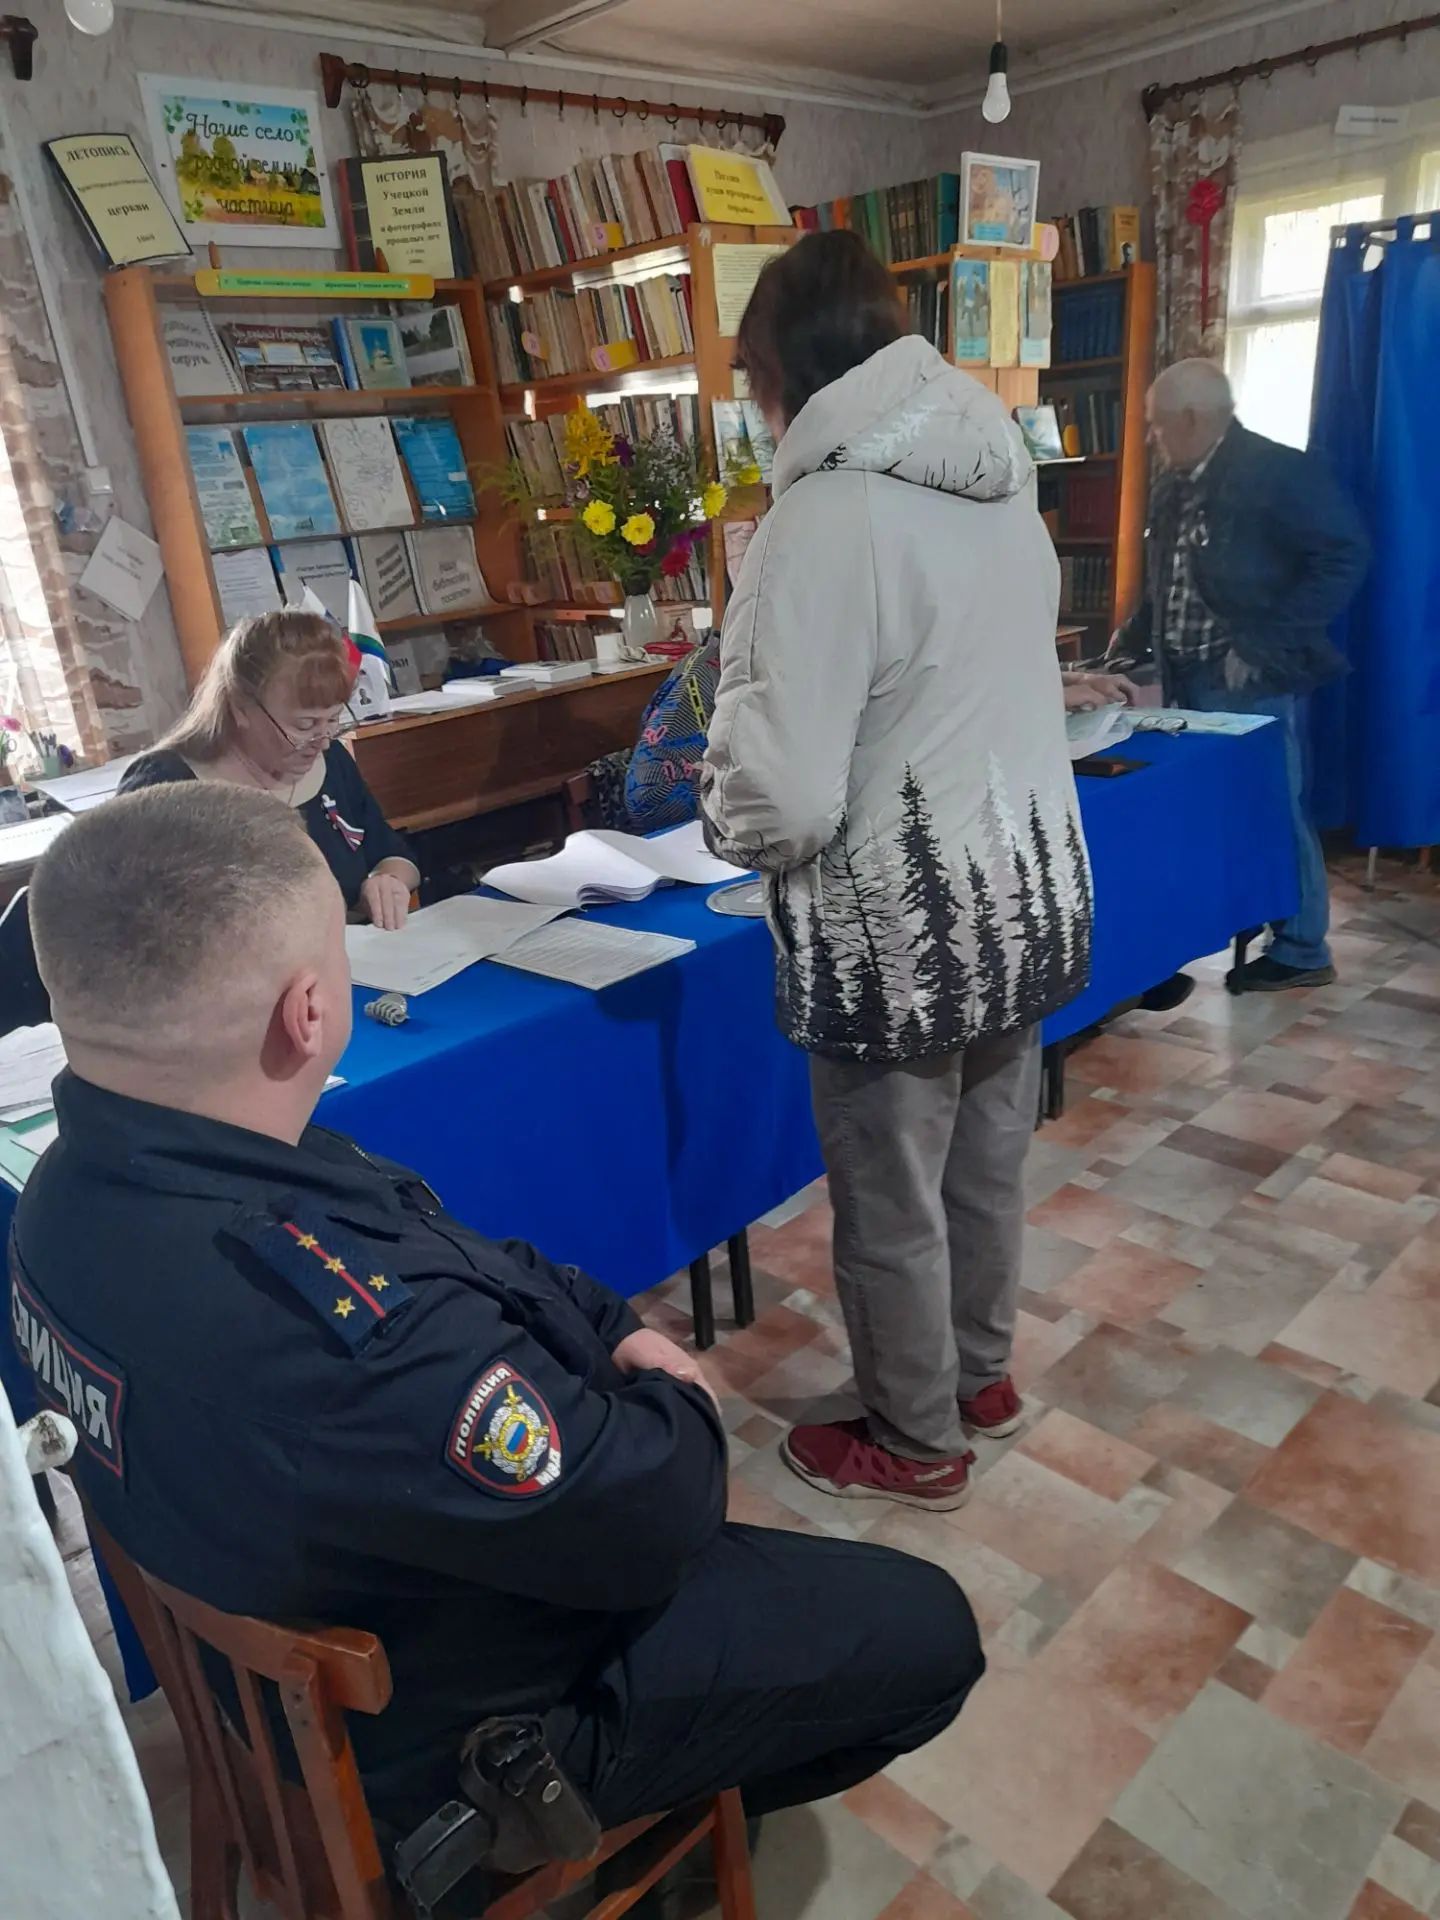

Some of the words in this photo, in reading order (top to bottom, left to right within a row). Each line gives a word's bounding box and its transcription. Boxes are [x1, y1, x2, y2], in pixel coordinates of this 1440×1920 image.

[186, 112, 249, 139] Наше
[255, 125, 295, 142] село
[66, 144, 131, 162] ЛЕТОПИСЬ
[193, 153, 250, 176] родной
[376, 169, 427, 183] ИСТОРИЯ
[107, 203, 150, 216] церкви
[216, 198, 296, 224] частица
[392, 206, 425, 216] Земли
[12, 1280, 112, 1449] ОЛИЦИЯ
[455, 1367, 512, 1458] ПОЛИЦИЯ
[535, 1447, 561, 1486] МВД
